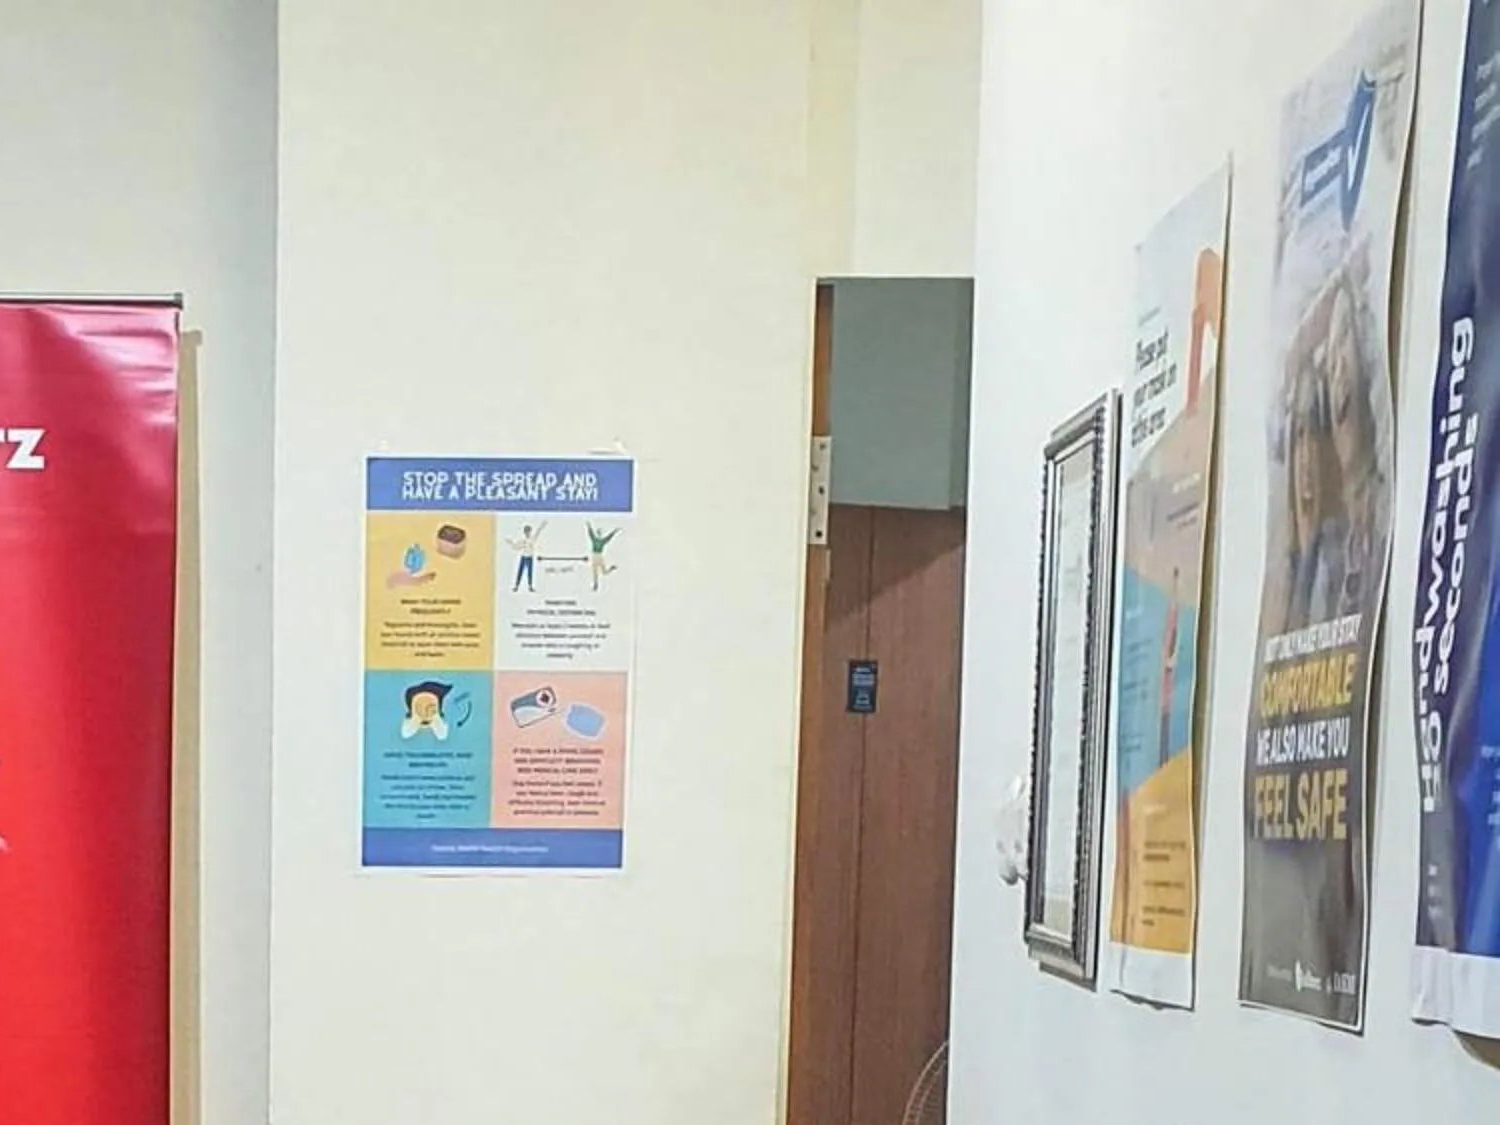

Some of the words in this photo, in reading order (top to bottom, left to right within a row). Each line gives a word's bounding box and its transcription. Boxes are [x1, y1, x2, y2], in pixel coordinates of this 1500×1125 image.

[402, 471, 449, 486] STOP
[454, 471, 489, 486] THE
[491, 472, 557, 487] SPREAD
[563, 472, 597, 487] AND
[402, 485, 444, 500] HAVE
[449, 486, 461, 499] A
[465, 485, 548, 500] PLEASANT
[1414, 316, 1475, 813] Handwashing
[1434, 412, 1479, 695] seconds
[1260, 653, 1358, 719] COMFORTABLE
[1256, 727, 1271, 766] WE
[1271, 724, 1295, 764] ALSO
[1297, 720, 1327, 762] MAKE
[1328, 716, 1351, 758] YOU
[1253, 772, 1294, 840] FEEL
[1296, 767, 1348, 841] SAFE
